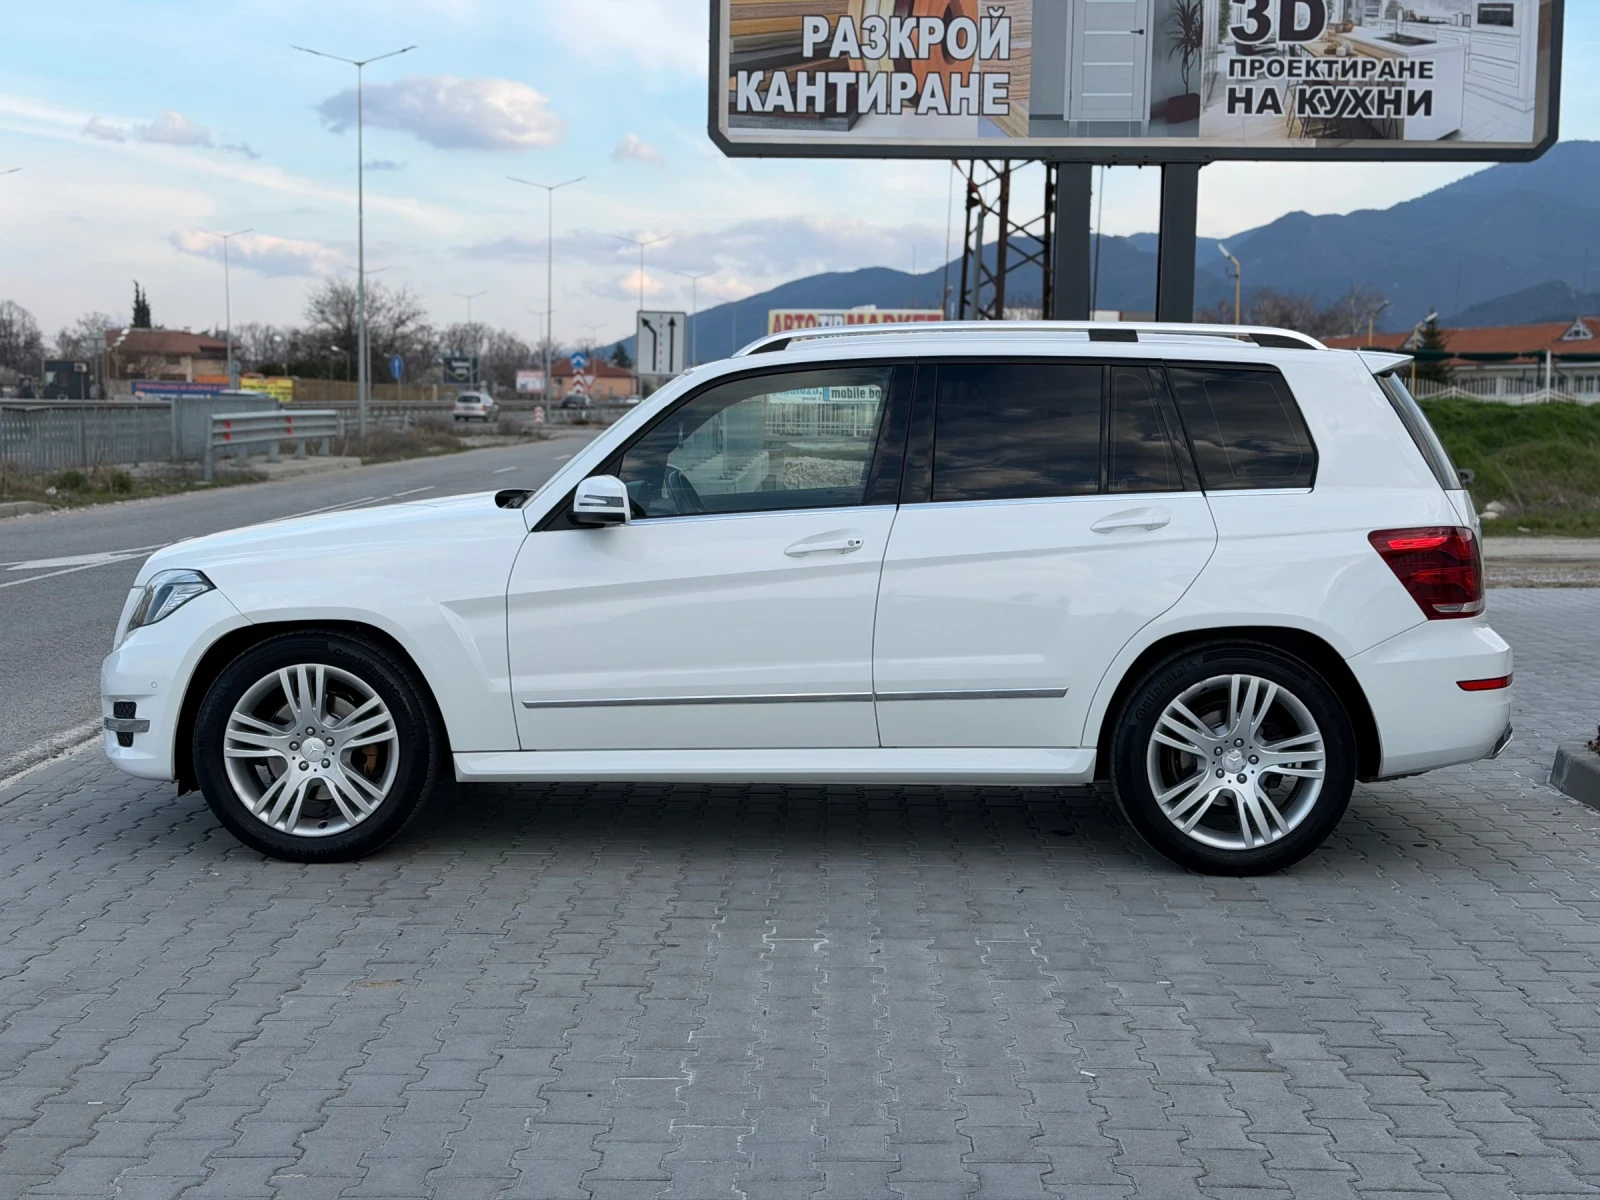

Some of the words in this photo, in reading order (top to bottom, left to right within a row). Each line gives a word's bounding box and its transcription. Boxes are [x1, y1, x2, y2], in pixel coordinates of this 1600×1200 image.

[802, 6, 1012, 60] РАЗКРОЙ
[1231, 0, 1325, 42] 3D
[1228, 59, 1434, 80] ПРОЕКТИРАНЕ
[736, 70, 1010, 116] КАНТИРАНЕ
[1226, 87, 1283, 115] НА
[1297, 88, 1433, 116] КУХНИ
[831, 387, 881, 399] mobile.bg
[1135, 664, 1187, 720] Continental
